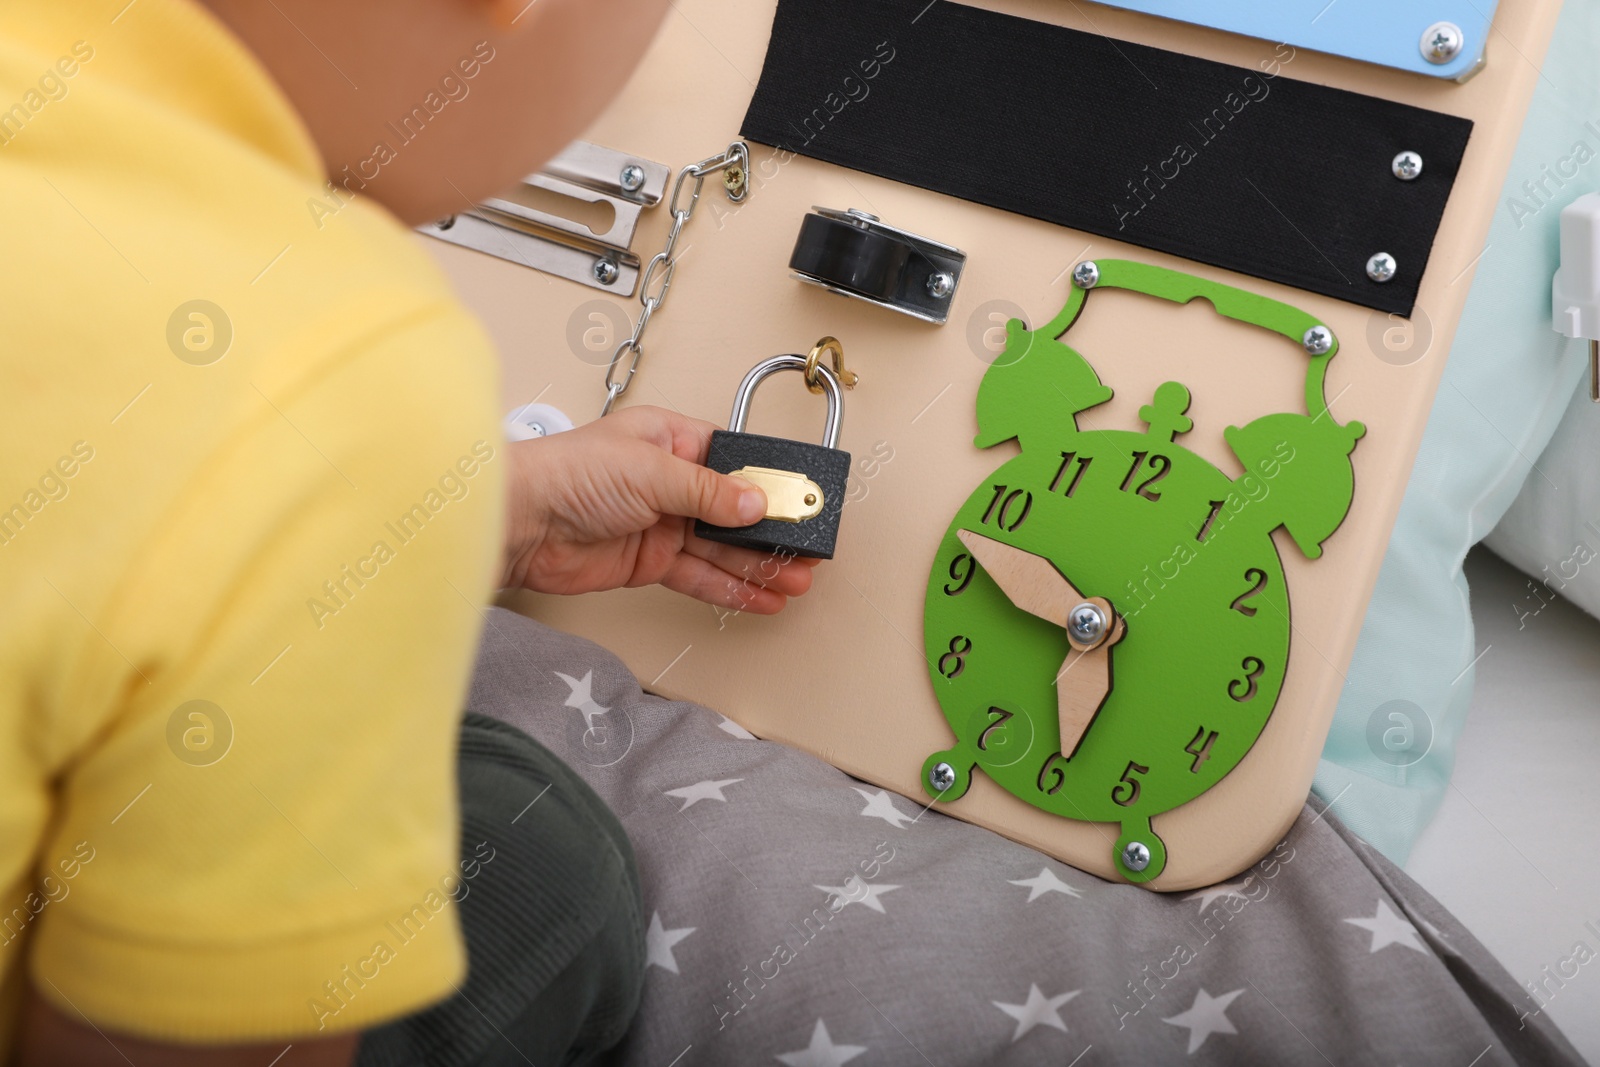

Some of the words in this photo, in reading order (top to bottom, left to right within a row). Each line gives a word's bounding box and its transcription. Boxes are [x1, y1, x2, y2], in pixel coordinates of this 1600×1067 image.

[1048, 451, 1093, 498] 11
[1119, 450, 1171, 502] 12
[980, 484, 1033, 532] 10
[1195, 499, 1225, 542] 1
[944, 553, 976, 596] 9
[1229, 567, 1268, 617] 2
[938, 635, 972, 679] 8
[1227, 656, 1265, 702] 3
[977, 706, 1014, 751] 7
[1184, 725, 1219, 774] 4
[1037, 751, 1065, 795] 6
[1111, 760, 1149, 807] 5
